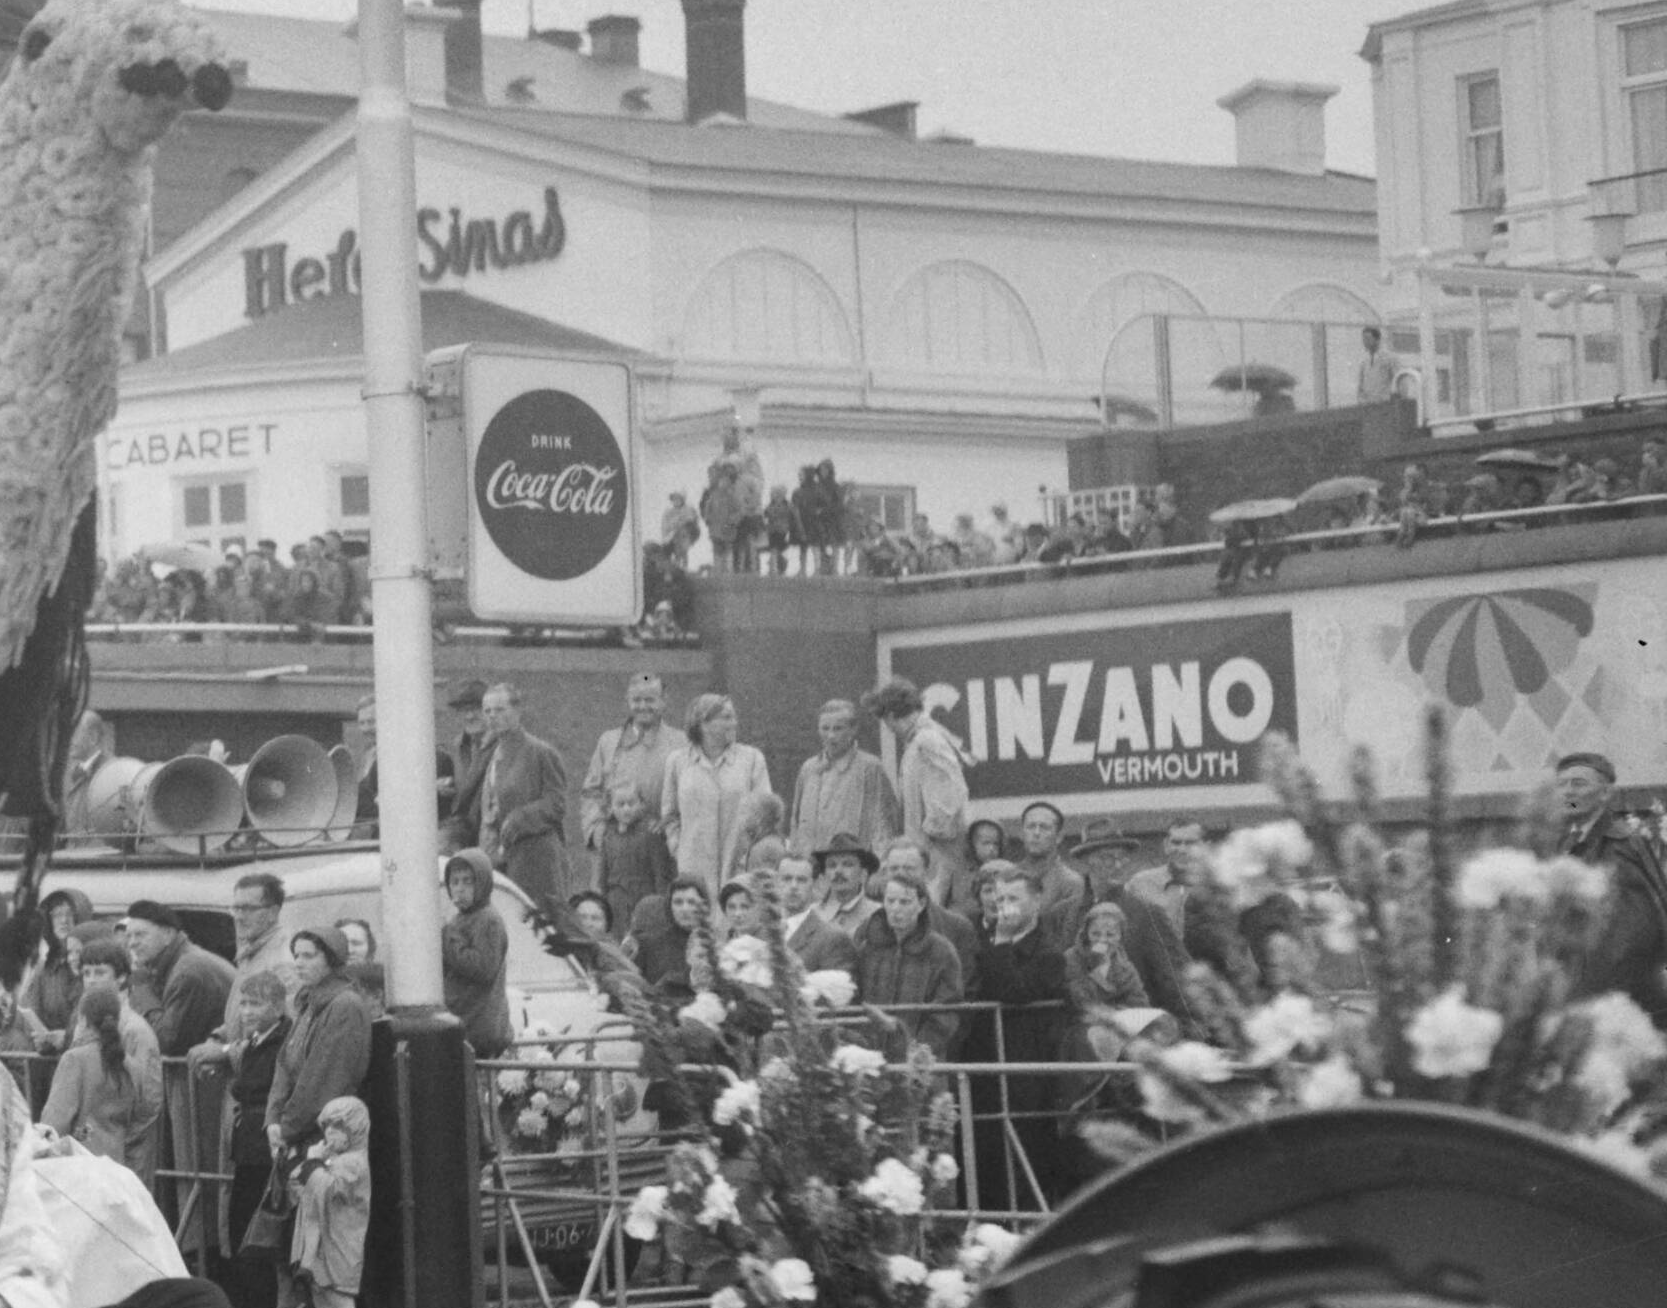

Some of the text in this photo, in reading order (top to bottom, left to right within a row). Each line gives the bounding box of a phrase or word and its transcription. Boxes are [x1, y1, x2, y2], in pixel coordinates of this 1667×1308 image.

[241, 230, 362, 318] Her
[106, 423, 279, 470] CABARET
[531, 433, 572, 451] DRINK
[486, 459, 618, 516] Coca-Cola
[1097, 751, 1239, 784] VERMOUTH
